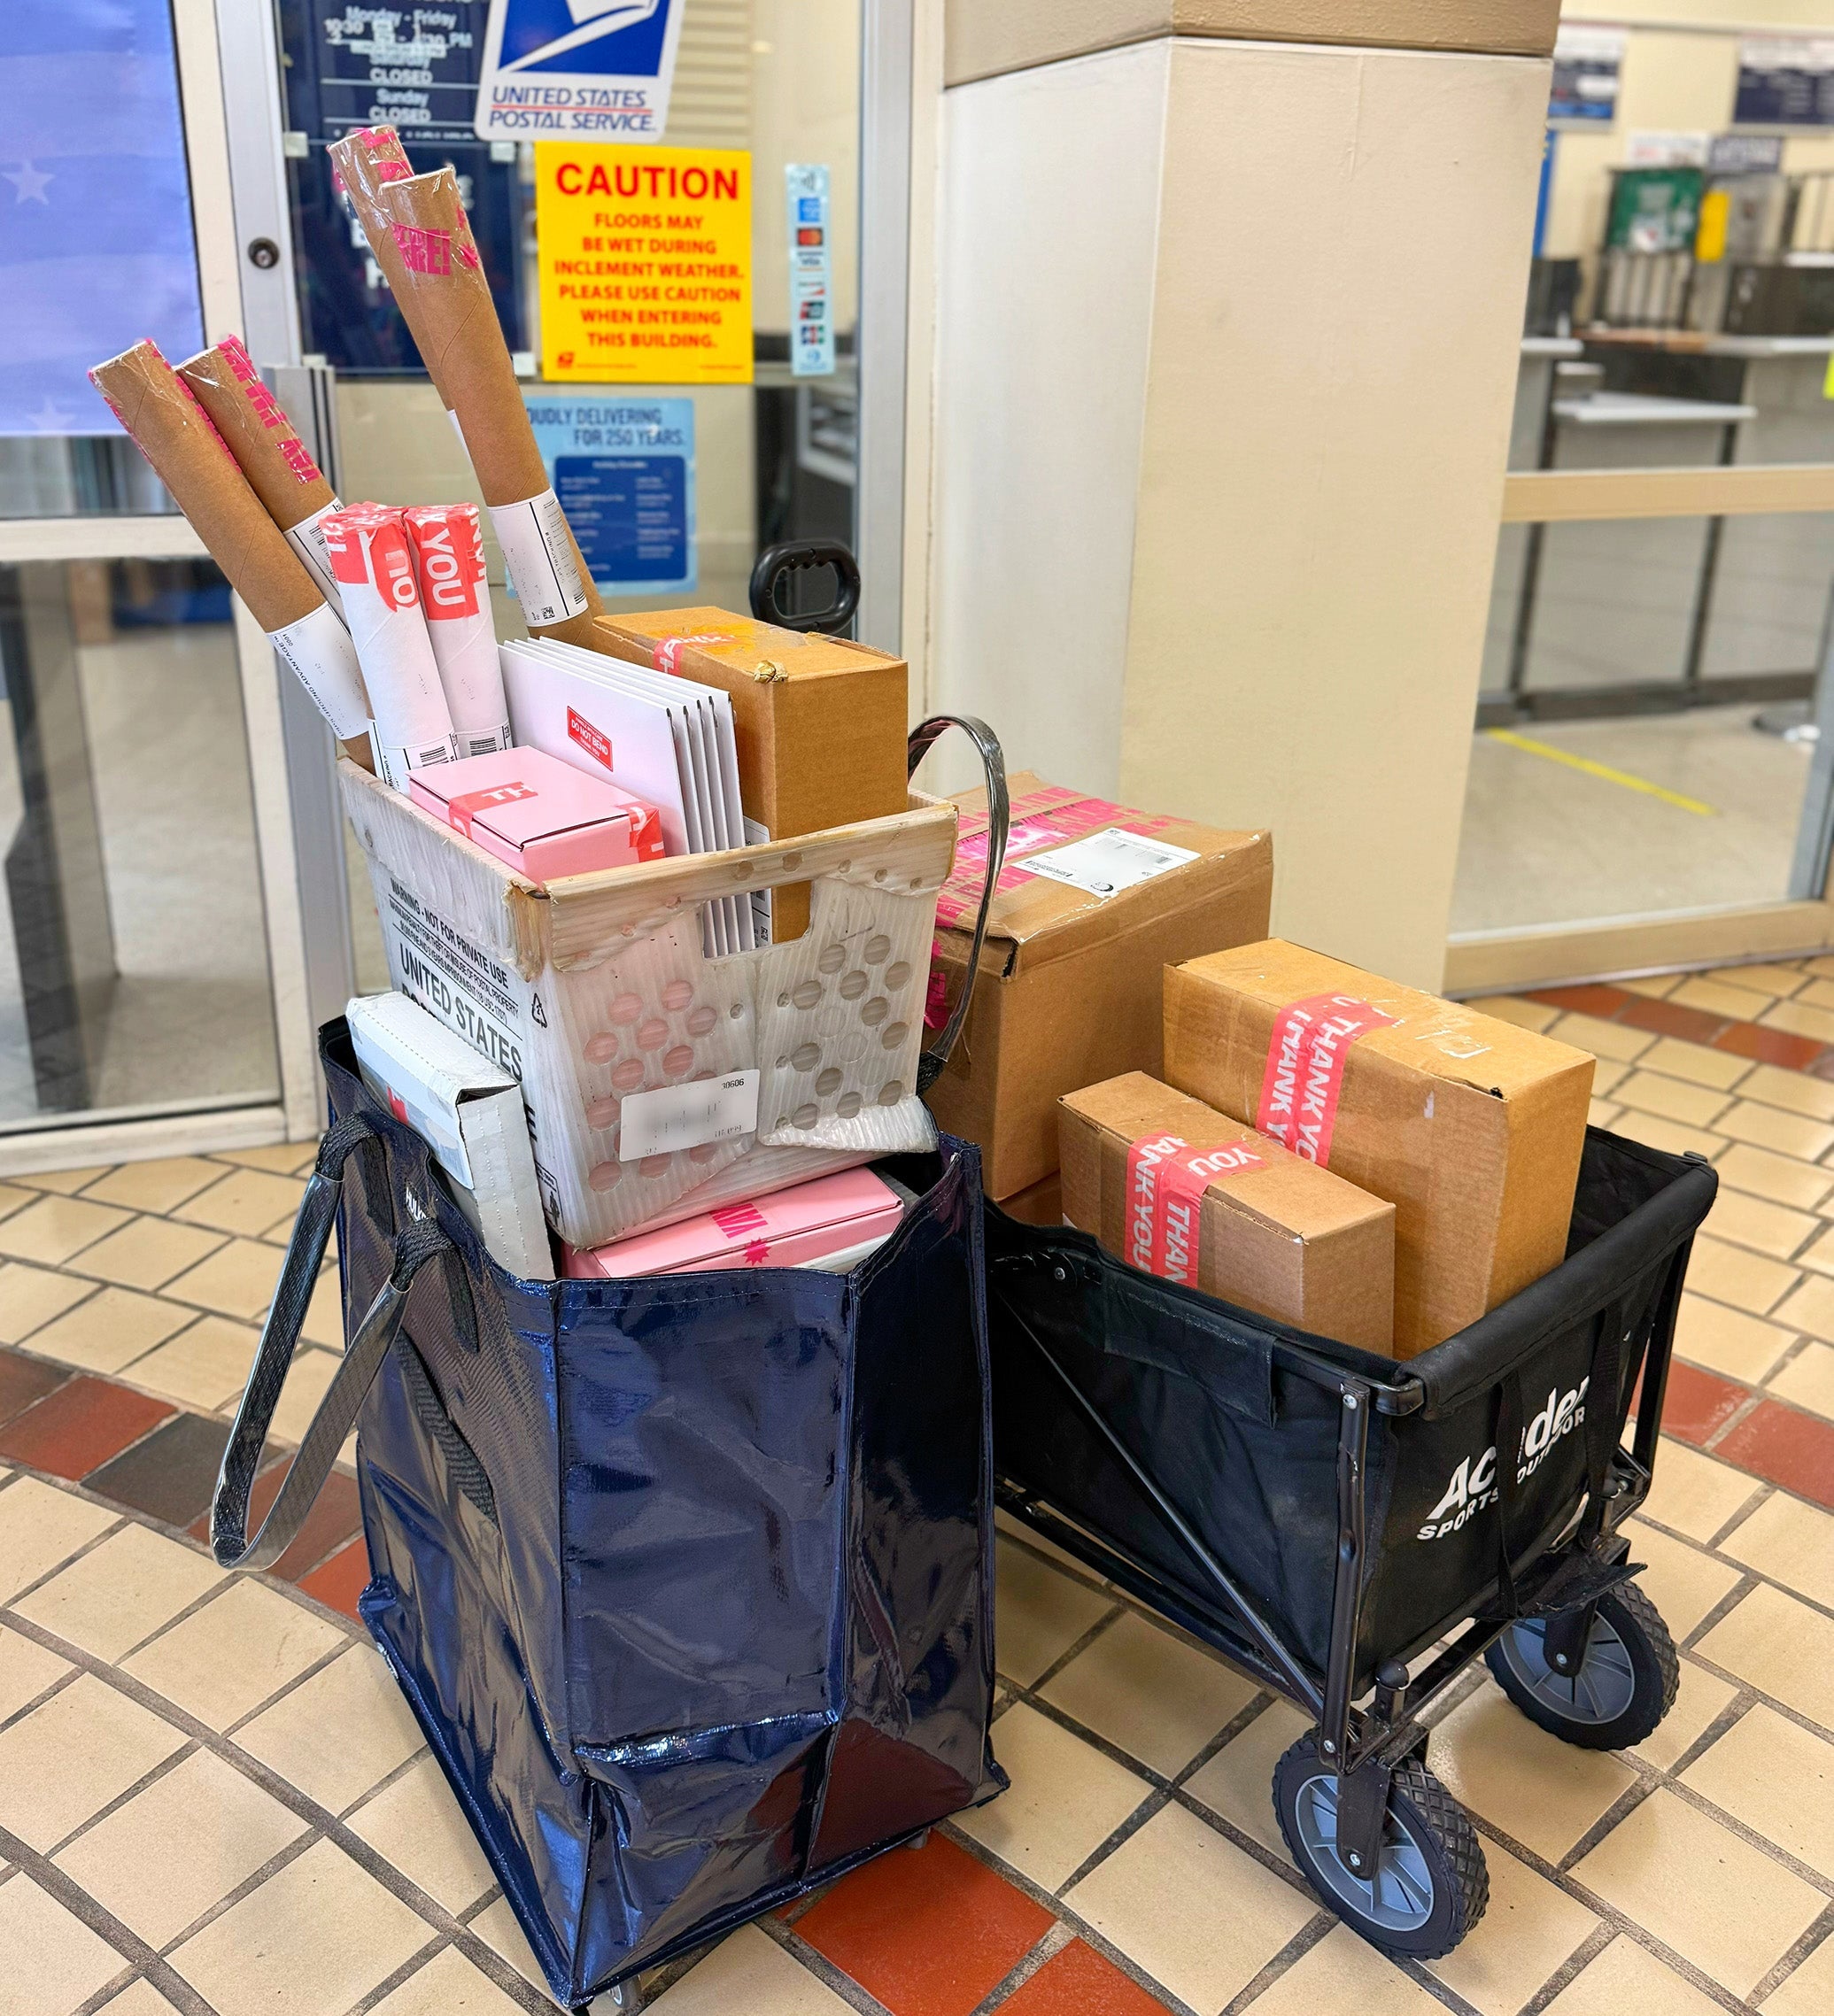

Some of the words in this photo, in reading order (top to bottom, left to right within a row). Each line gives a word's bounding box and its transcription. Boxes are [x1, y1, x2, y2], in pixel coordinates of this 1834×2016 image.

[414, 9, 457, 30] Friday
[369, 67, 433, 85] CLOSED
[376, 88, 429, 108] Sunday
[492, 86, 572, 105] UNITED
[576, 89, 647, 108] STATES
[368, 105, 431, 123] CLOSED
[489, 110, 566, 129] POSTAL
[556, 162, 739, 200] CAUTION
[594, 212, 662, 229] FLOORS
[667, 215, 704, 229] MAY
[582, 236, 604, 252] BE
[607, 237, 645, 253] WET
[649, 239, 717, 255] DURING
[554, 260, 654, 277] INCLEMENT
[658, 263, 745, 280] WEATHER.
[559, 283, 623, 300] PLEASE
[628, 285, 660, 301] USE
[664, 286, 741, 303] CAUTION
[581, 309, 633, 324] WHEN
[638, 310, 723, 326] ENTERING
[587, 332, 626, 347] THIS
[630, 333, 718, 349] BUILDING.
[526, 407, 572, 426] OUDLY
[576, 407, 662, 426] DELIVERING
[574, 429, 603, 445] FOR
[606, 429, 633, 445] 250
[421, 528, 466, 606] YOU
[571, 718, 580, 732] DO
[579, 726, 592, 743] NOT
[592, 736, 608, 756] BEND
[391, 877, 421, 915] WARNING
[424, 908, 439, 931] NOT
[440, 920, 457, 947] FOR
[456, 933, 489, 974] PRIVATE
[490, 962, 509, 989] USE
[399, 942, 452, 1016] UNITED
[455, 996, 523, 1082] STATES
[1301, 1016, 1363, 1122] THANK
[1295, 1122, 1322, 1163] YO
[1188, 1147, 1262, 1178] YOU
[1165, 1201, 1190, 1283] THAN
